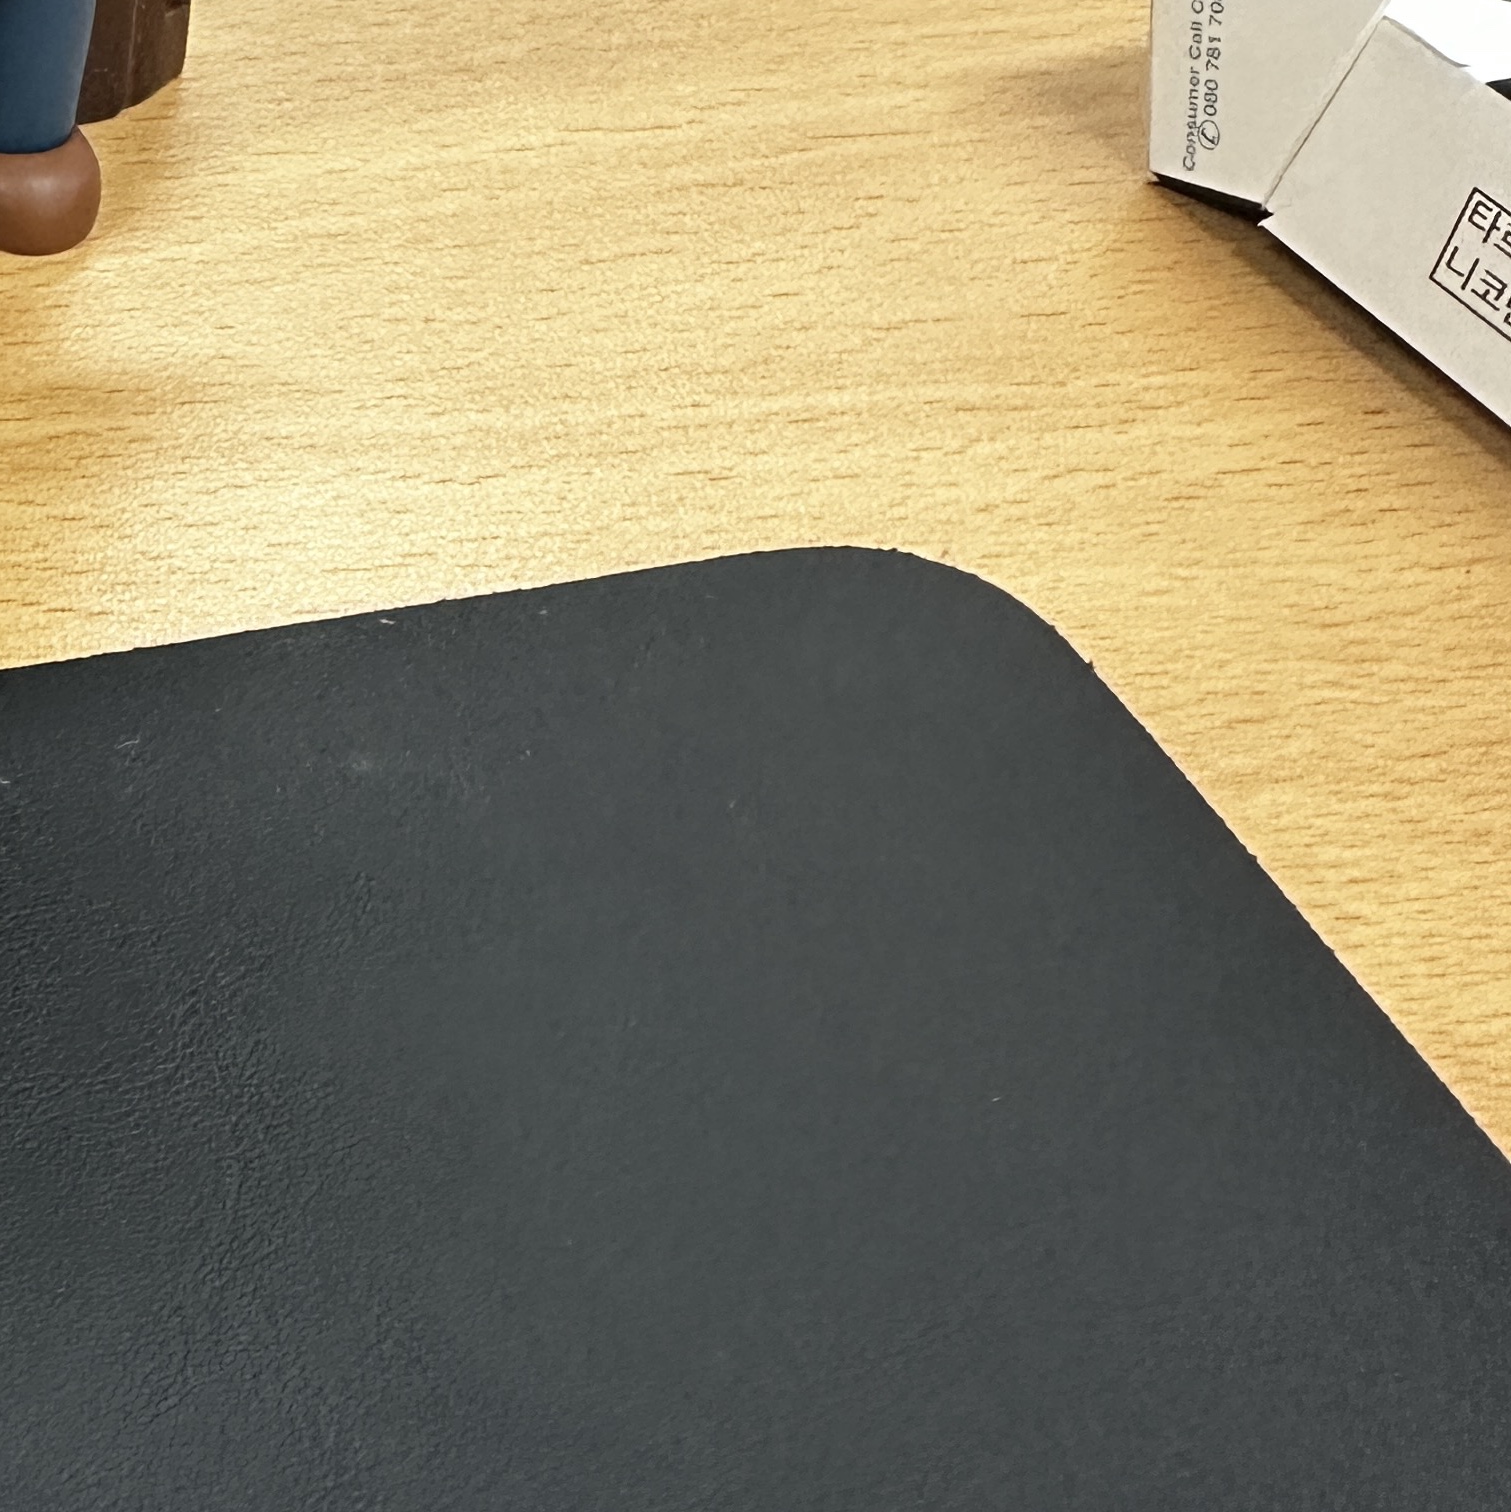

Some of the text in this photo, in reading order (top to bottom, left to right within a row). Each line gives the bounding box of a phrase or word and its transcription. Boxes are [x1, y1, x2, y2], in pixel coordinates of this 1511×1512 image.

[1188, 21, 1203, 60] Call
[1205, 36, 1222, 71] 781
[1444, 244, 1511, 329] 니코
